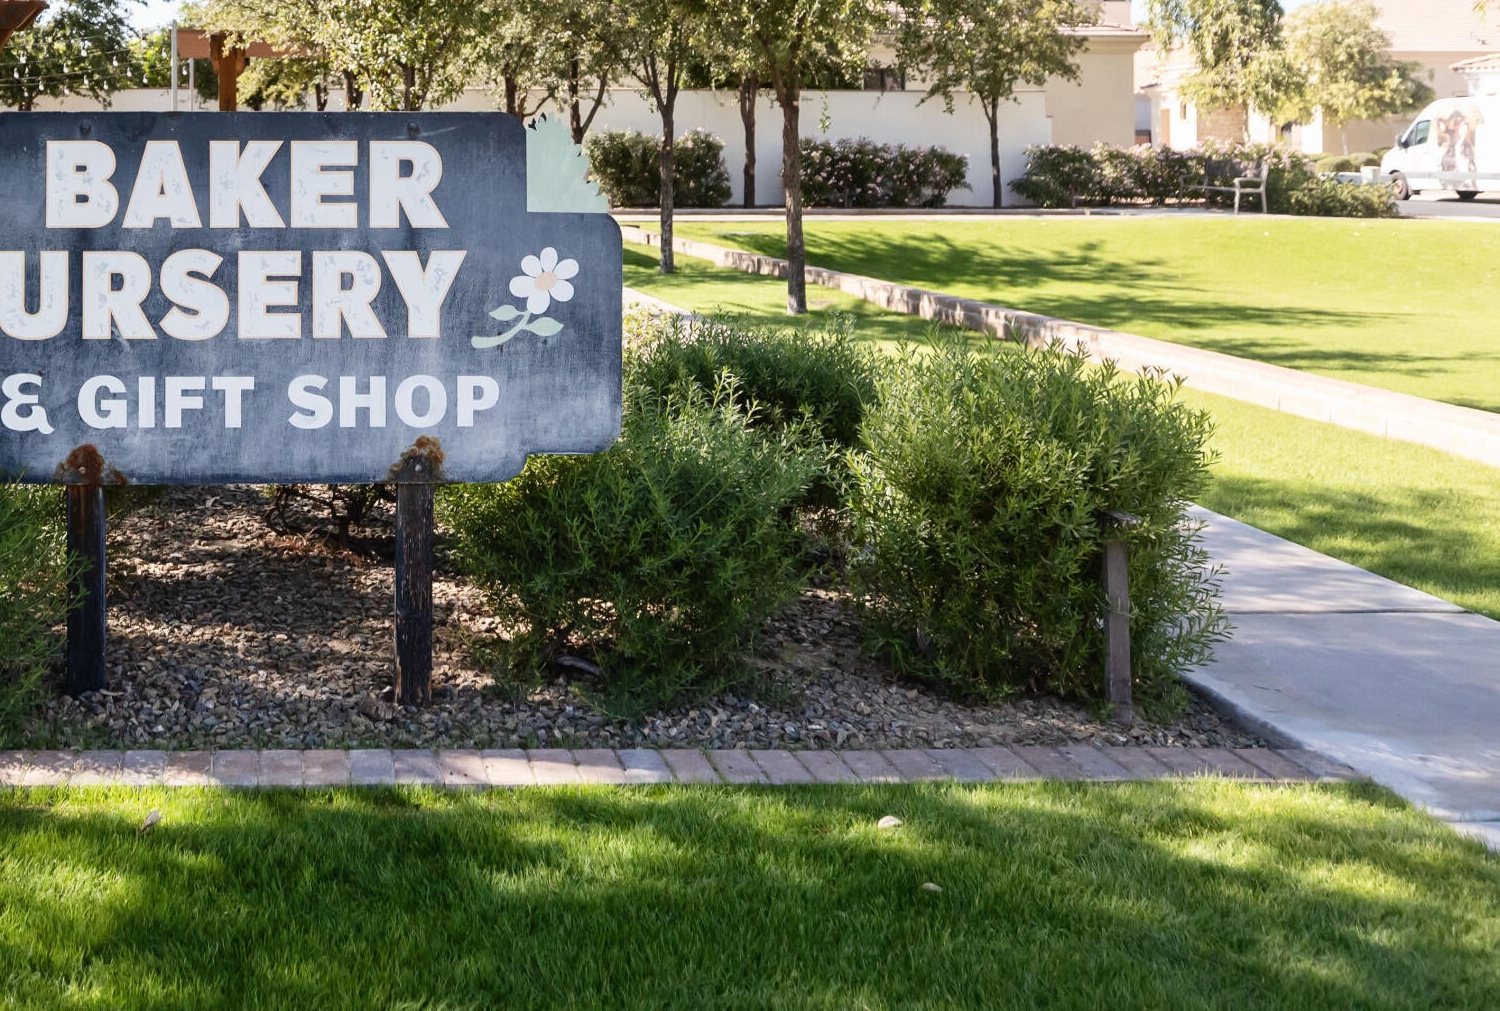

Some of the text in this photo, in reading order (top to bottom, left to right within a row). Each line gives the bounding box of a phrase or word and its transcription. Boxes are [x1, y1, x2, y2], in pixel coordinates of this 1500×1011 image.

[45, 139, 449, 229] BAKER
[0, 373, 500, 435] & GIFT SHOP
